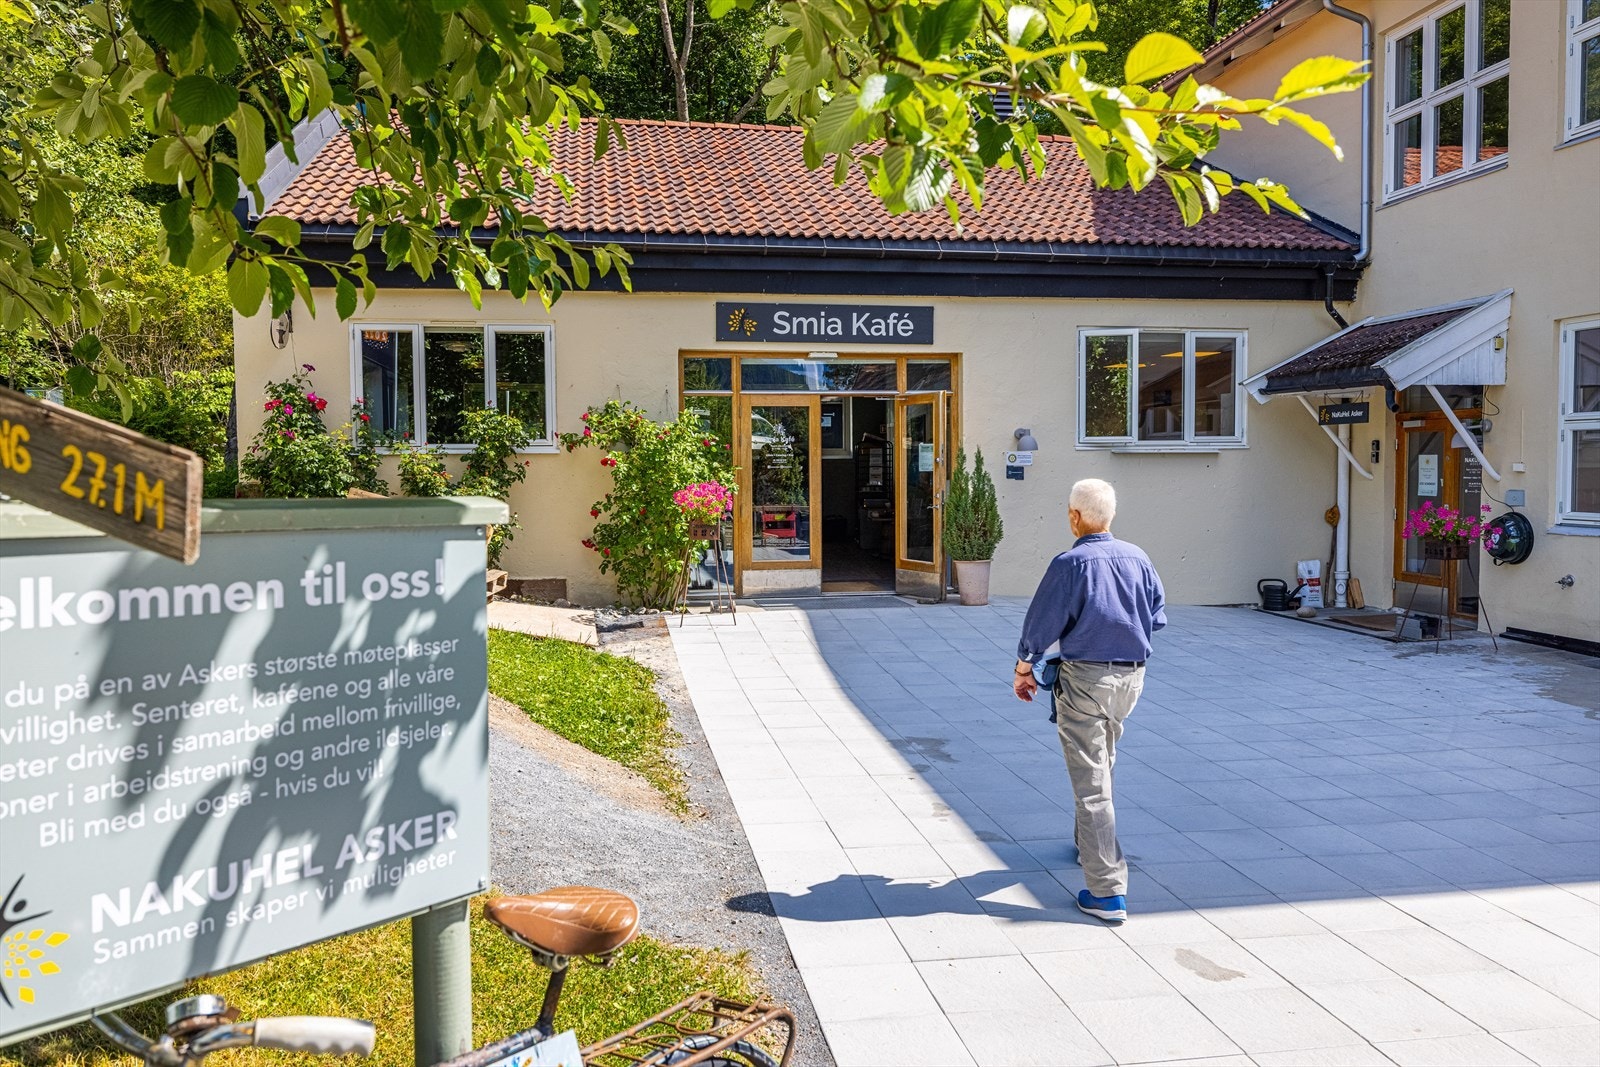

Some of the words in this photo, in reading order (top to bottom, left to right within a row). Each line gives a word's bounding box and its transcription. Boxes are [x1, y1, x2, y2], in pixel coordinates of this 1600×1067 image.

[773, 311, 842, 336] Smia
[852, 312, 914, 337] Kafé
[300, 561, 346, 607] til
[362, 558, 444, 602] oss!
[0, 710, 122, 745] villighet.
[132, 693, 245, 727] Senteret,
[253, 681, 339, 709] kaféene
[345, 678, 371, 699] og
[378, 669, 411, 691] alle
[416, 664, 454, 685] våre
[5, 680, 44, 708] du
[55, 674, 90, 711] på
[100, 677, 133, 696] en
[142, 672, 172, 691] av
[178, 660, 258, 687] Askers
[265, 652, 337, 676] største
[344, 637, 459, 666] møteplasser
[0, 756, 59, 783] eter
[67, 742, 149, 771] drives
[157, 734, 164, 756] i
[172, 713, 295, 754] samarbeid
[302, 705, 378, 733] mellom
[385, 693, 461, 719] frivillige,
[67, 783, 74, 807] i
[84, 755, 267, 804] arbeidstrening
[275, 750, 304, 771] og
[310, 734, 370, 761] andre
[377, 720, 453, 750] ildsjeler.
[39, 818, 74, 848] Bli
[84, 804, 145, 839] med
[153, 798, 187, 824] du
[195, 783, 252, 818] også
[276, 774, 317, 798] hvis
[323, 766, 350, 789] du
[357, 758, 384, 782] vil!
[91, 844, 323, 934] NAKUHEL
[335, 810, 458, 870] ASKER
[93, 916, 215, 964] Sammen
[225, 889, 309, 927] skaper
[316, 878, 334, 902] vi
[342, 849, 457, 896] muligheter
